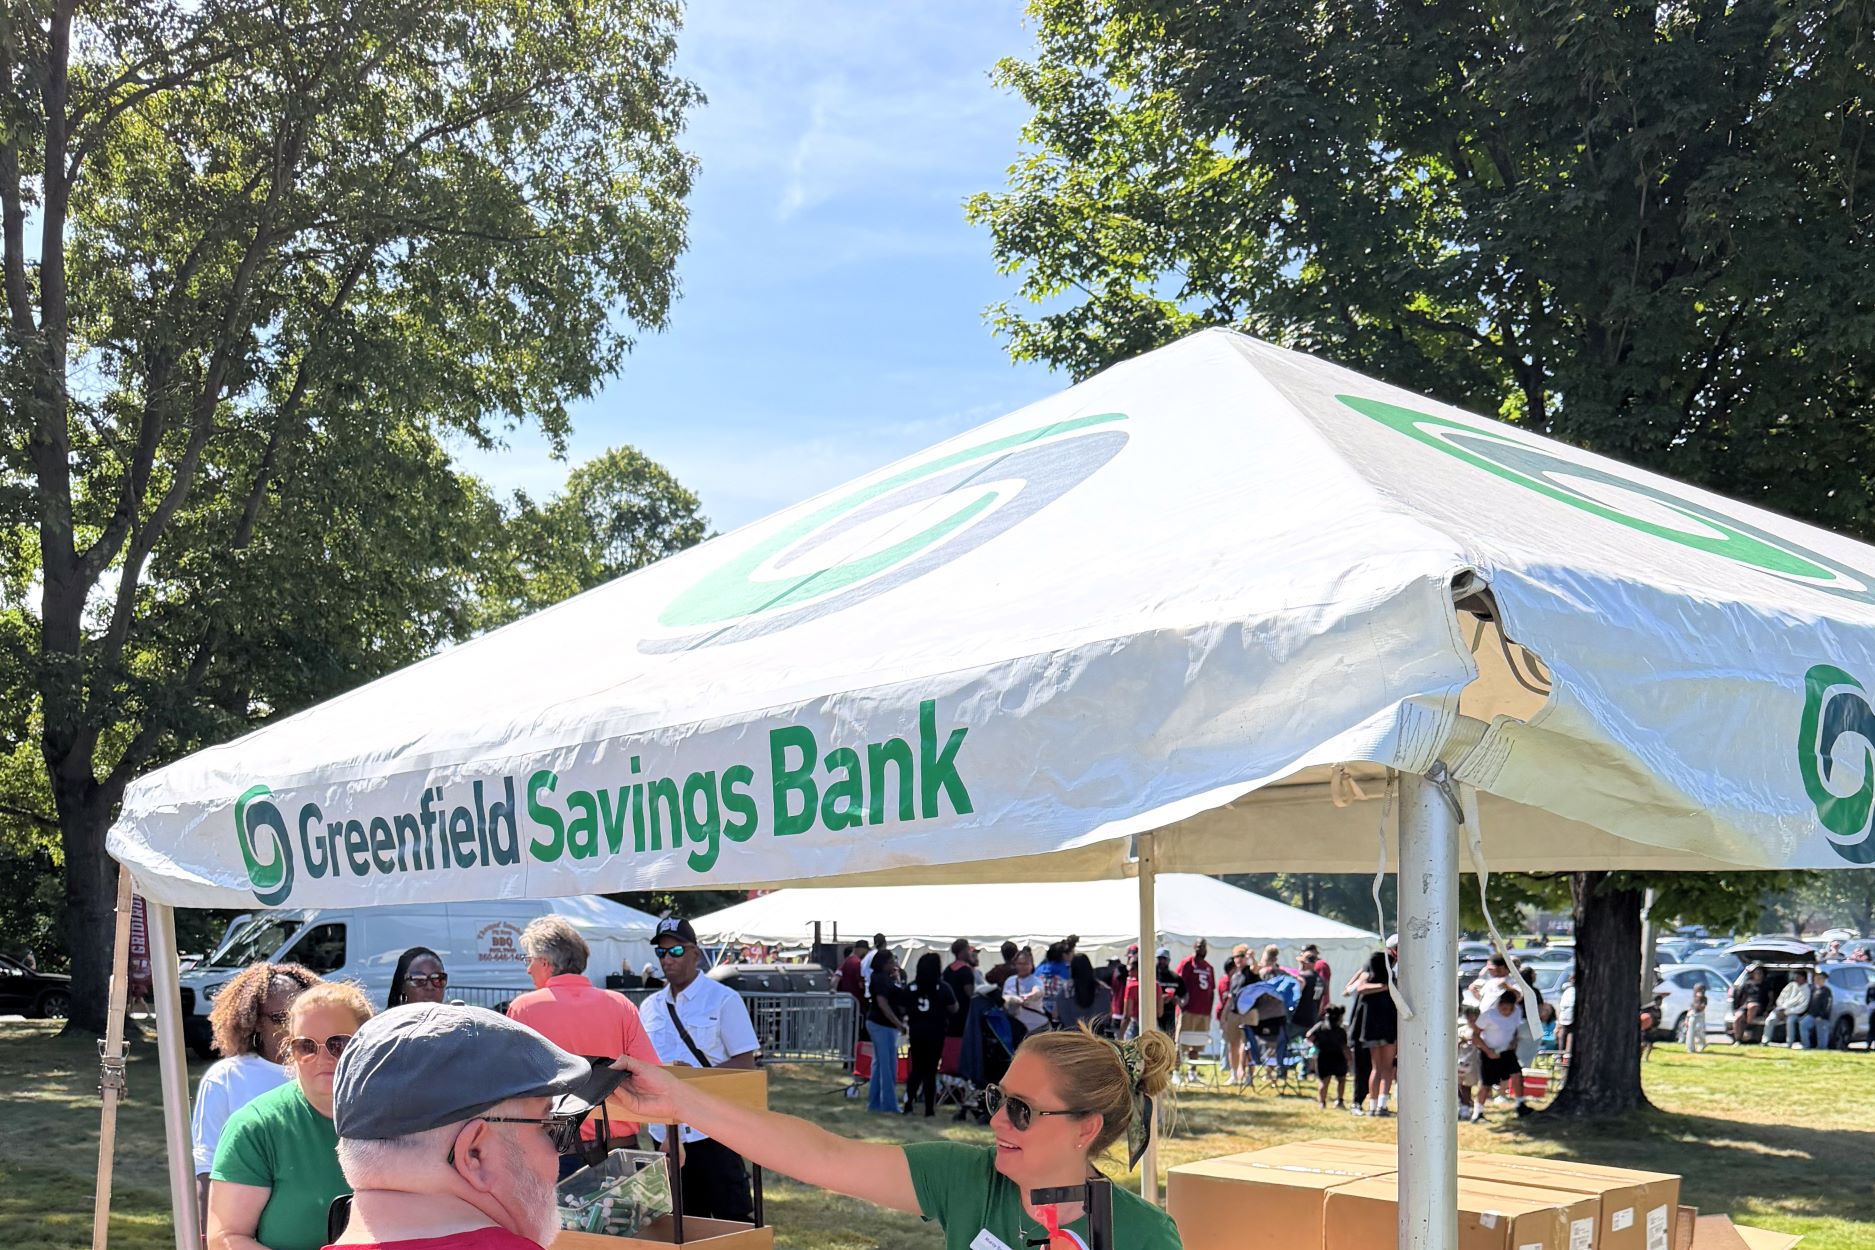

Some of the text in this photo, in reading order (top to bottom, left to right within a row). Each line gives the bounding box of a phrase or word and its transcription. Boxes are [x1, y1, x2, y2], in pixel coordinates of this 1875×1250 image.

[301, 700, 974, 879] Greenfield Savings Bank
